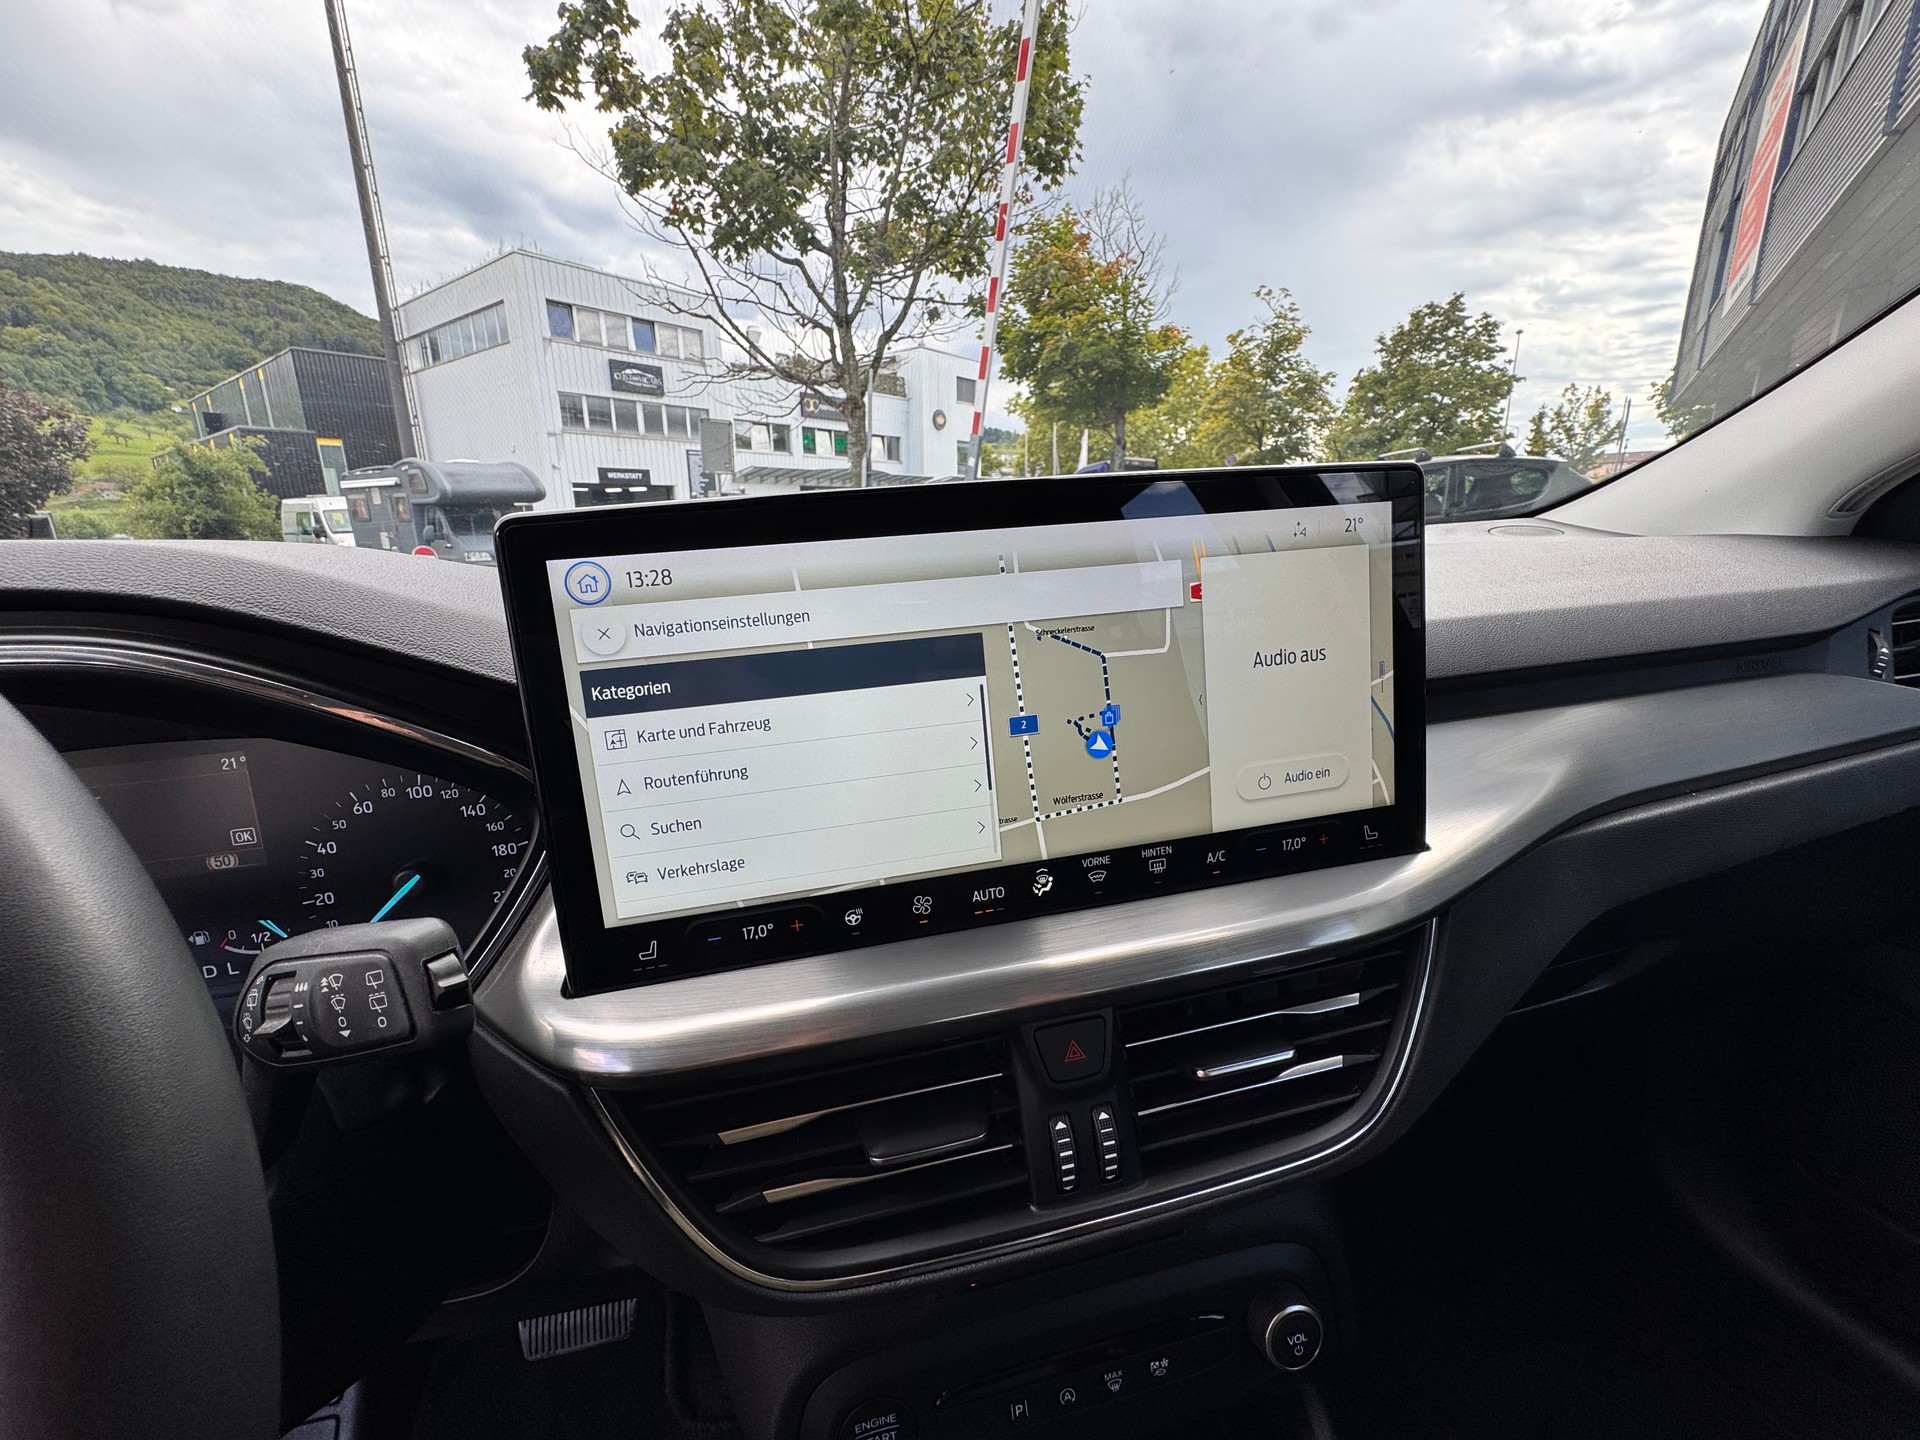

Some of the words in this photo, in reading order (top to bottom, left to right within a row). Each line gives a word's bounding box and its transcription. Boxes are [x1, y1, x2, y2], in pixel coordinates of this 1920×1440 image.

[606, 471, 643, 480] WERKSTATT
[1344, 517, 1364, 533] 21°
[625, 568, 673, 589] 13:28
[634, 611, 811, 638] Navigationseinstellungen
[1035, 625, 1095, 637] Schneckelerstrasse
[1253, 648, 1297, 669] Audio
[1300, 648, 1327, 663] aus
[591, 681, 672, 702] Kategorien
[636, 729, 676, 744] Karte
[679, 723, 706, 739] und
[708, 718, 772, 736] Fahrzeug
[1021, 720, 1027, 730] 2
[220, 755, 246, 771] 21°
[644, 767, 749, 790] Routenführung
[1284, 769, 1313, 784] Audio
[1315, 767, 1331, 779] ein
[381, 788, 396, 798] 80
[405, 785, 433, 800] 100
[440, 788, 459, 800] 120
[1052, 791, 1104, 806] Wölferstrasse
[353, 801, 373, 815] 60
[460, 803, 486, 818] 140
[332, 819, 347, 830] 50
[485, 821, 505, 832] 160
[650, 818, 702, 836] Suchen
[235, 831, 253, 843] OK
[317, 841, 337, 855] 40
[491, 842, 517, 857] 180
[1141, 845, 1173, 859] HINTEN
[1081, 855, 1111, 868] VORNE
[1206, 850, 1226, 863] A/C
[309, 868, 325, 879] 30
[657, 858, 746, 881] Verkehrslage
[314, 892, 335, 906] 20
[972, 886, 1006, 903] AUTO
[325, 919, 339, 929] 10
[227, 929, 237, 940] 0
[251, 931, 272, 943] 1/2
[202, 965, 218, 979] D
[226, 962, 240, 976] L
[1286, 1332, 1308, 1346] VOL
[1104, 1370, 1123, 1382] MAX
[854, 1413, 897, 1434] ENGINE
